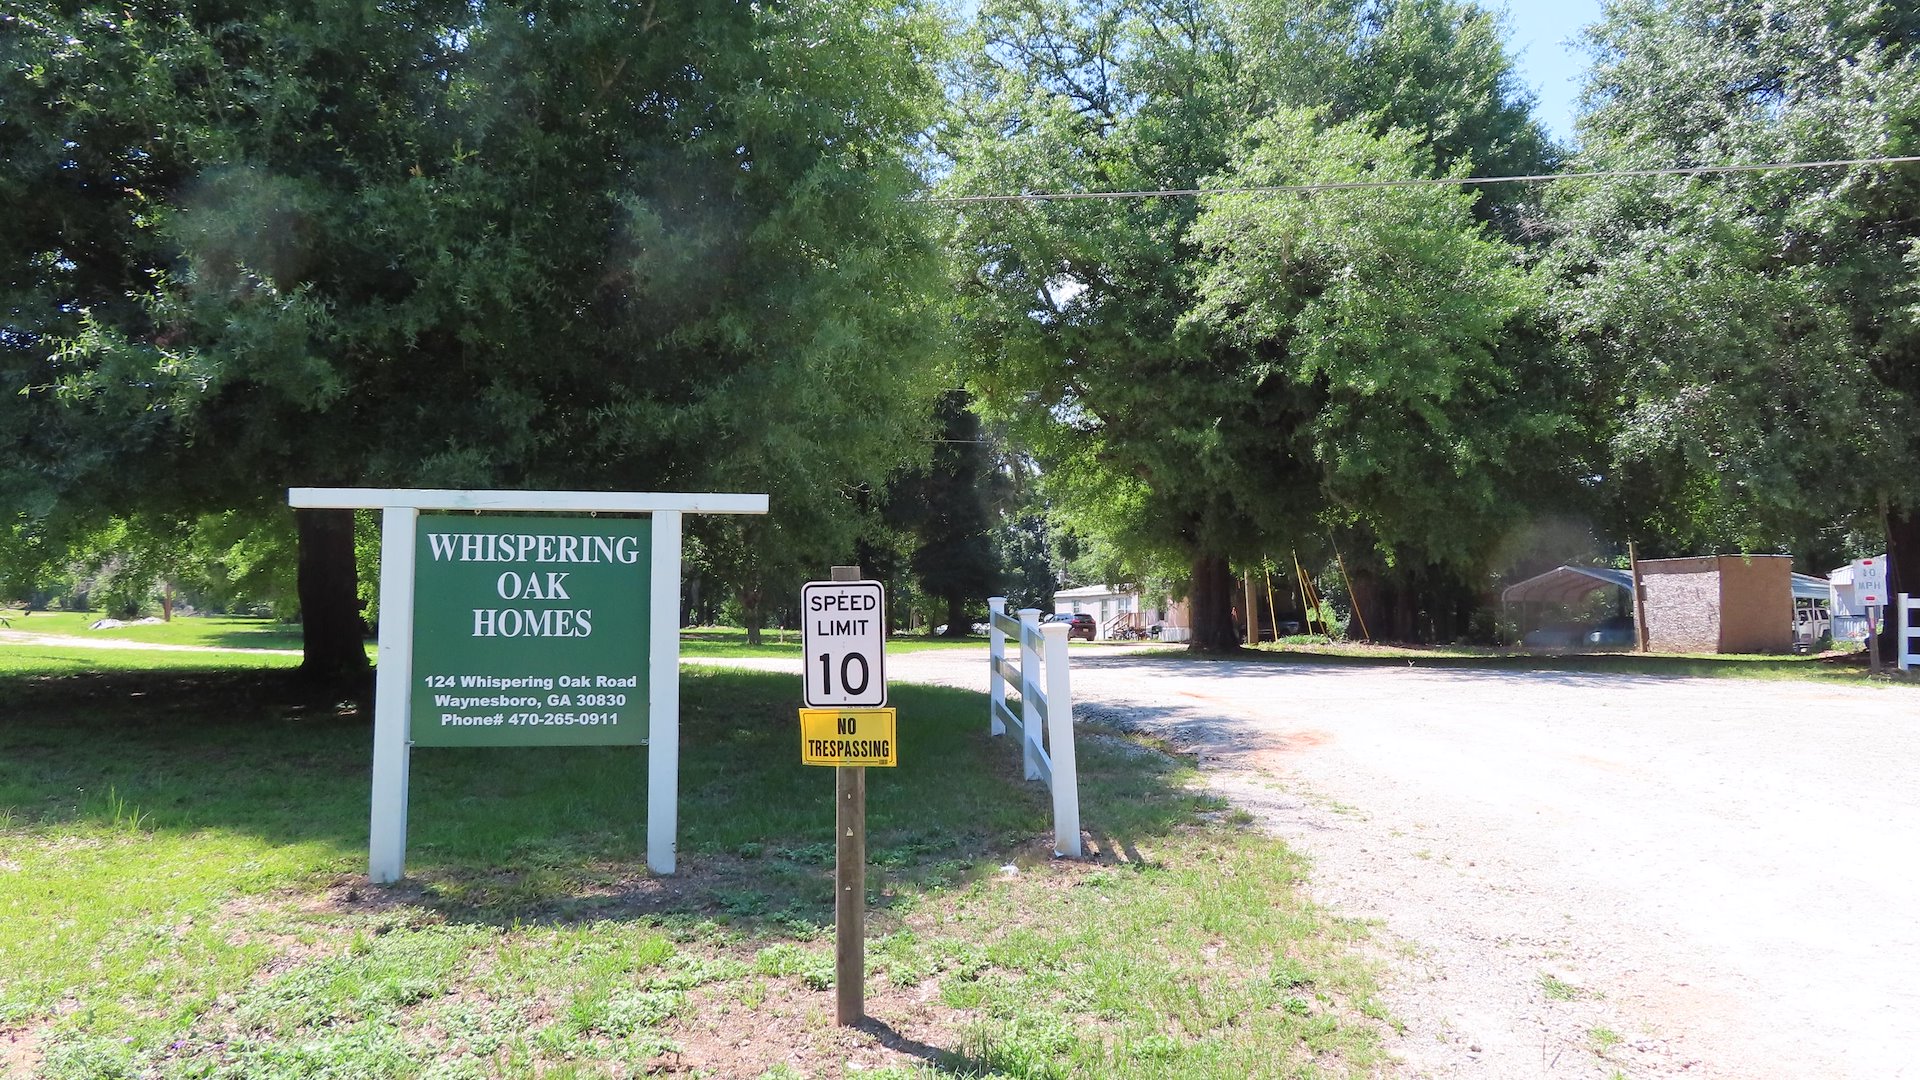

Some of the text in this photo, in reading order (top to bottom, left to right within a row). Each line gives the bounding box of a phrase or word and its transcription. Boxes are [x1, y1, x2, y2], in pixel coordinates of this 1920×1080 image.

[427, 533, 640, 564] WHISPERING
[1863, 568, 1876, 577] 10
[497, 571, 570, 600] OAK
[1858, 581, 1881, 590] MPH
[810, 595, 876, 612] SPEED
[471, 609, 592, 638] HOMES
[818, 620, 869, 636] LIMIT
[819, 652, 870, 696] 10
[425, 675, 637, 691] 124 Whispering Oak Road
[435, 695, 626, 710] Waynesboro, GA 30830
[441, 713, 618, 726] Phone# 470-265-0911
[837, 717, 857, 735] NO
[808, 739, 890, 758] TRESPASSING
